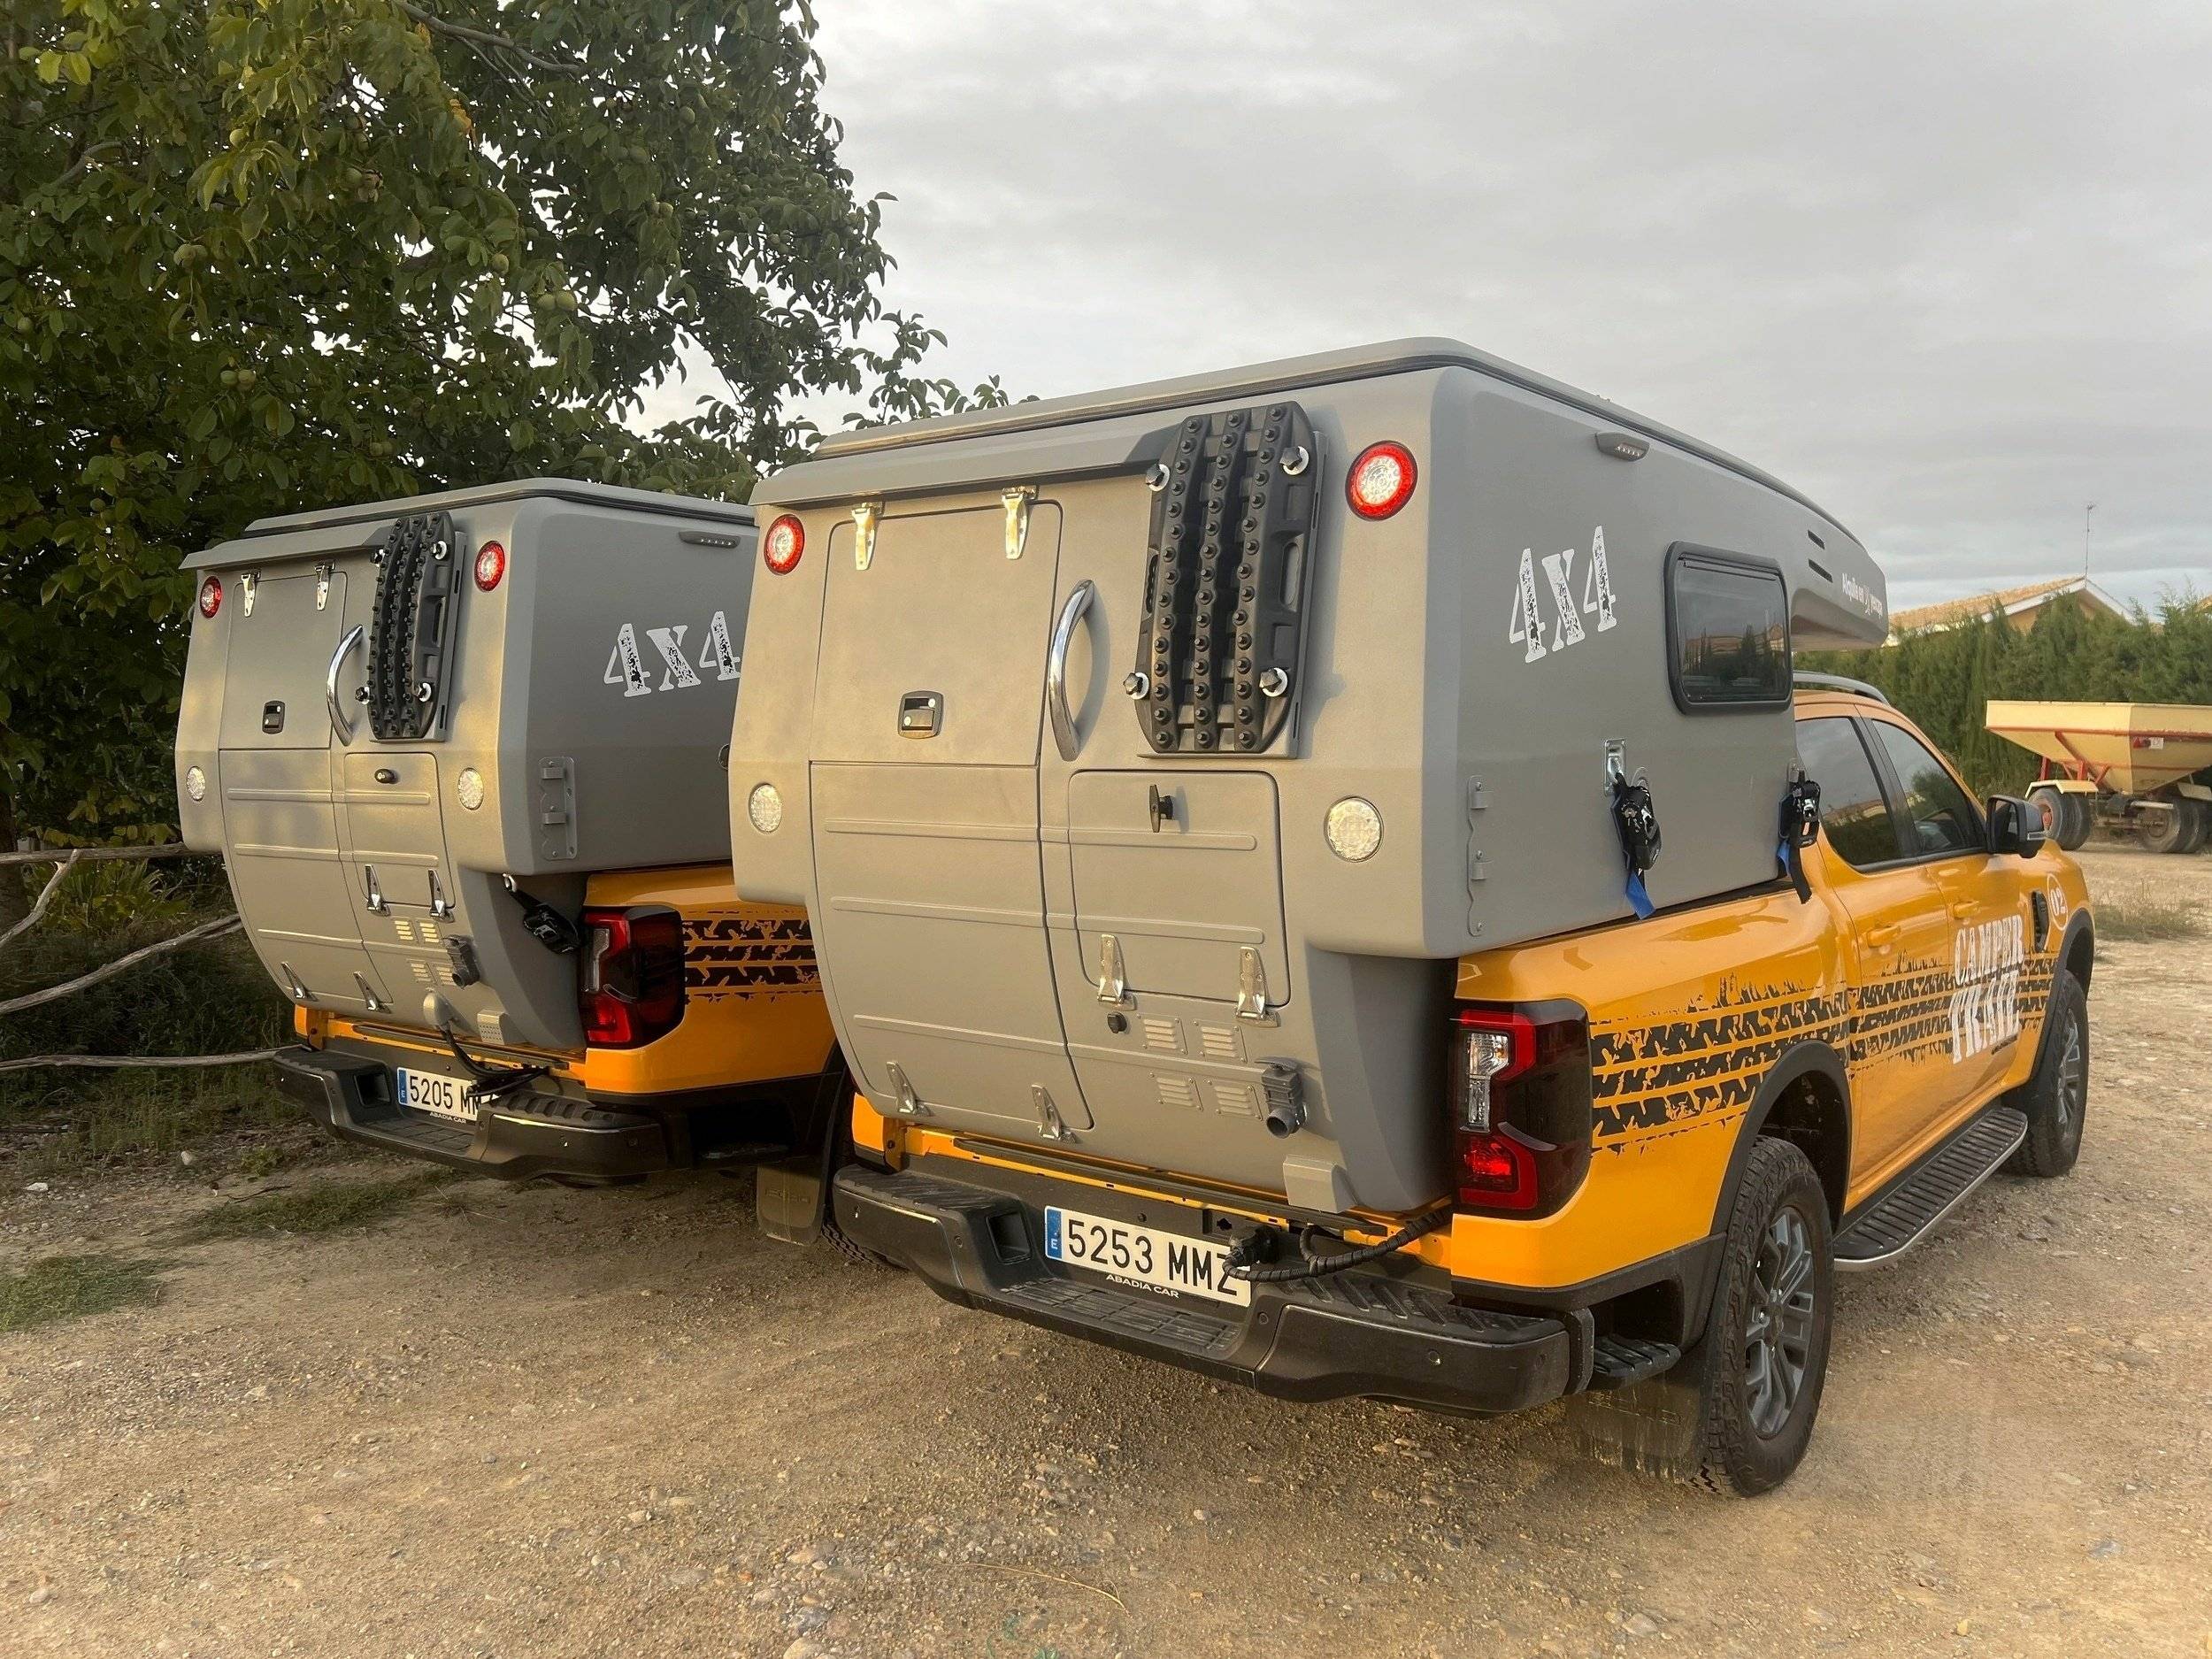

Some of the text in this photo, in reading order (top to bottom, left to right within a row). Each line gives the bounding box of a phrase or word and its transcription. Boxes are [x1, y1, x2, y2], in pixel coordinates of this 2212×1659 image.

[1955, 915, 2024, 986] CAMPER
[410, 1076, 493, 1115] 5205 MM
[1051, 1239, 1057, 1250] E
[1069, 1219, 1237, 1296] 5253 MMZ
[1106, 1274, 1179, 1298] ABADIA CAR
